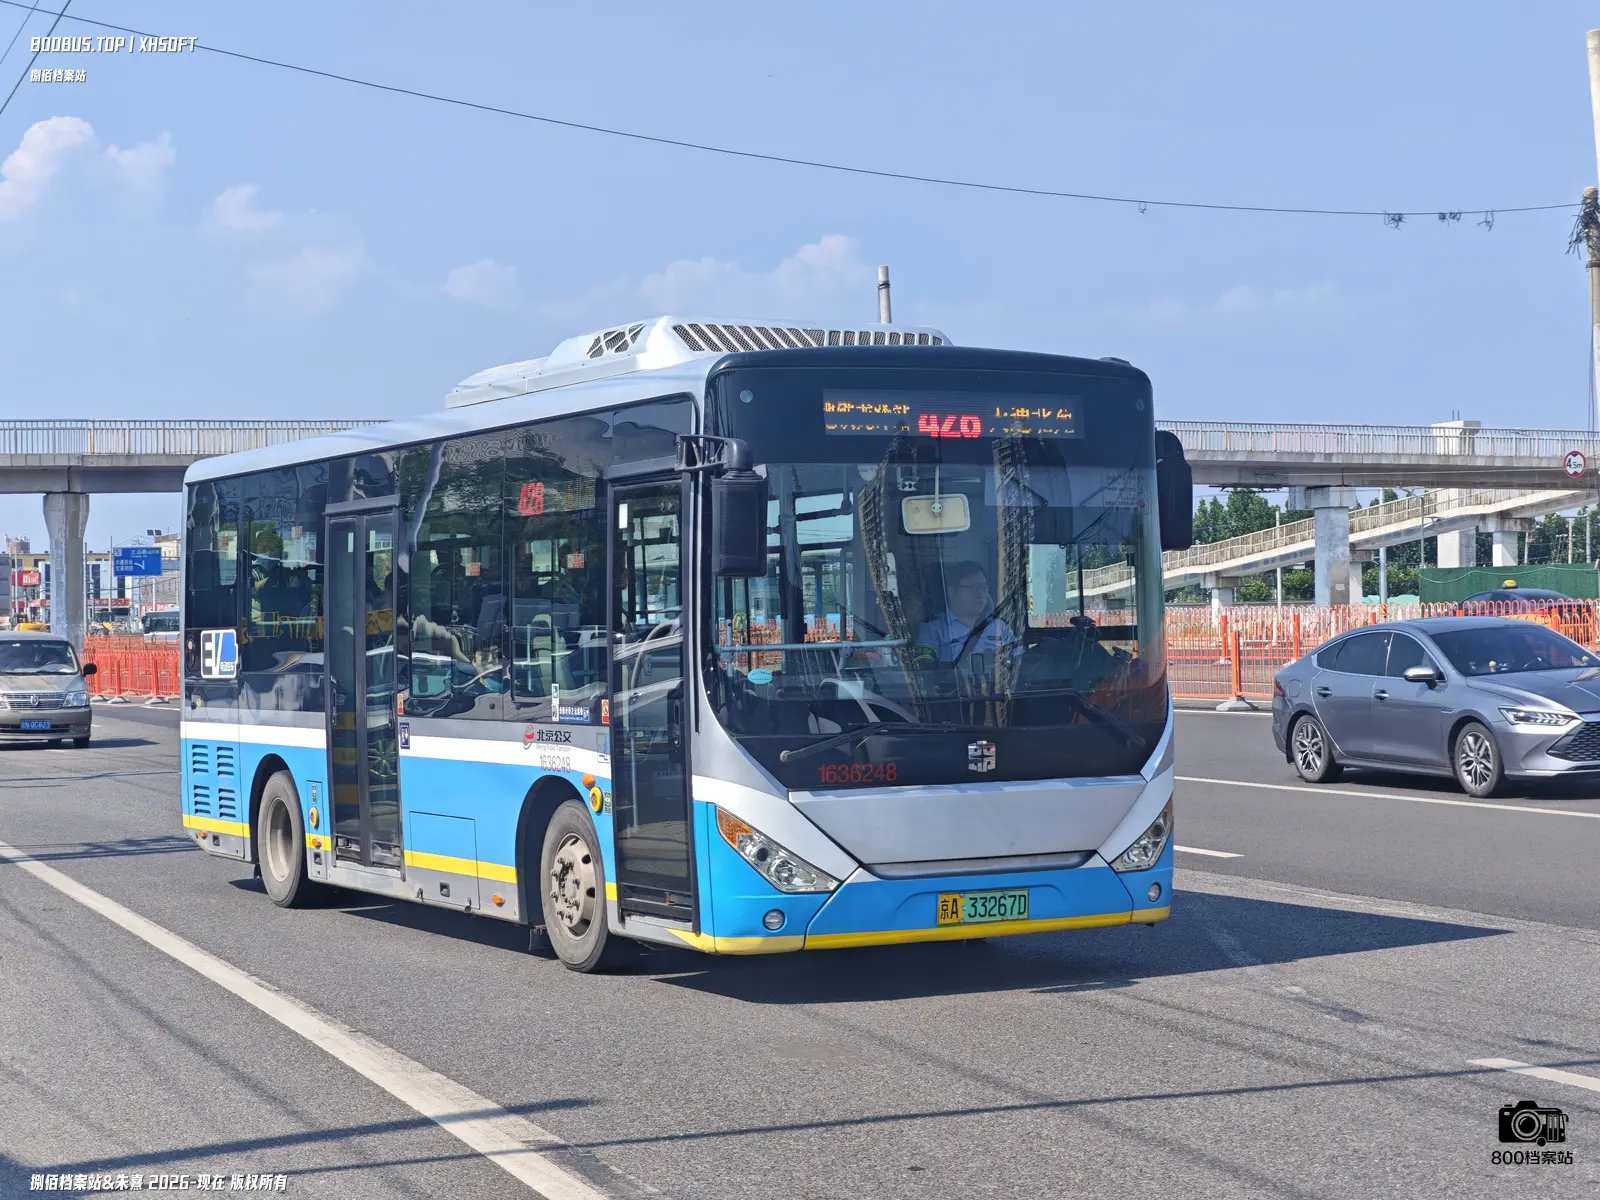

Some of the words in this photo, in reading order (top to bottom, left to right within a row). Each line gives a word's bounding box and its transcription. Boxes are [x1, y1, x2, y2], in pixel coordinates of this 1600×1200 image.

[536, 729, 572, 743] 北京公交
[540, 754, 571, 773] 1636248
[817, 762, 897, 783] 1636248
